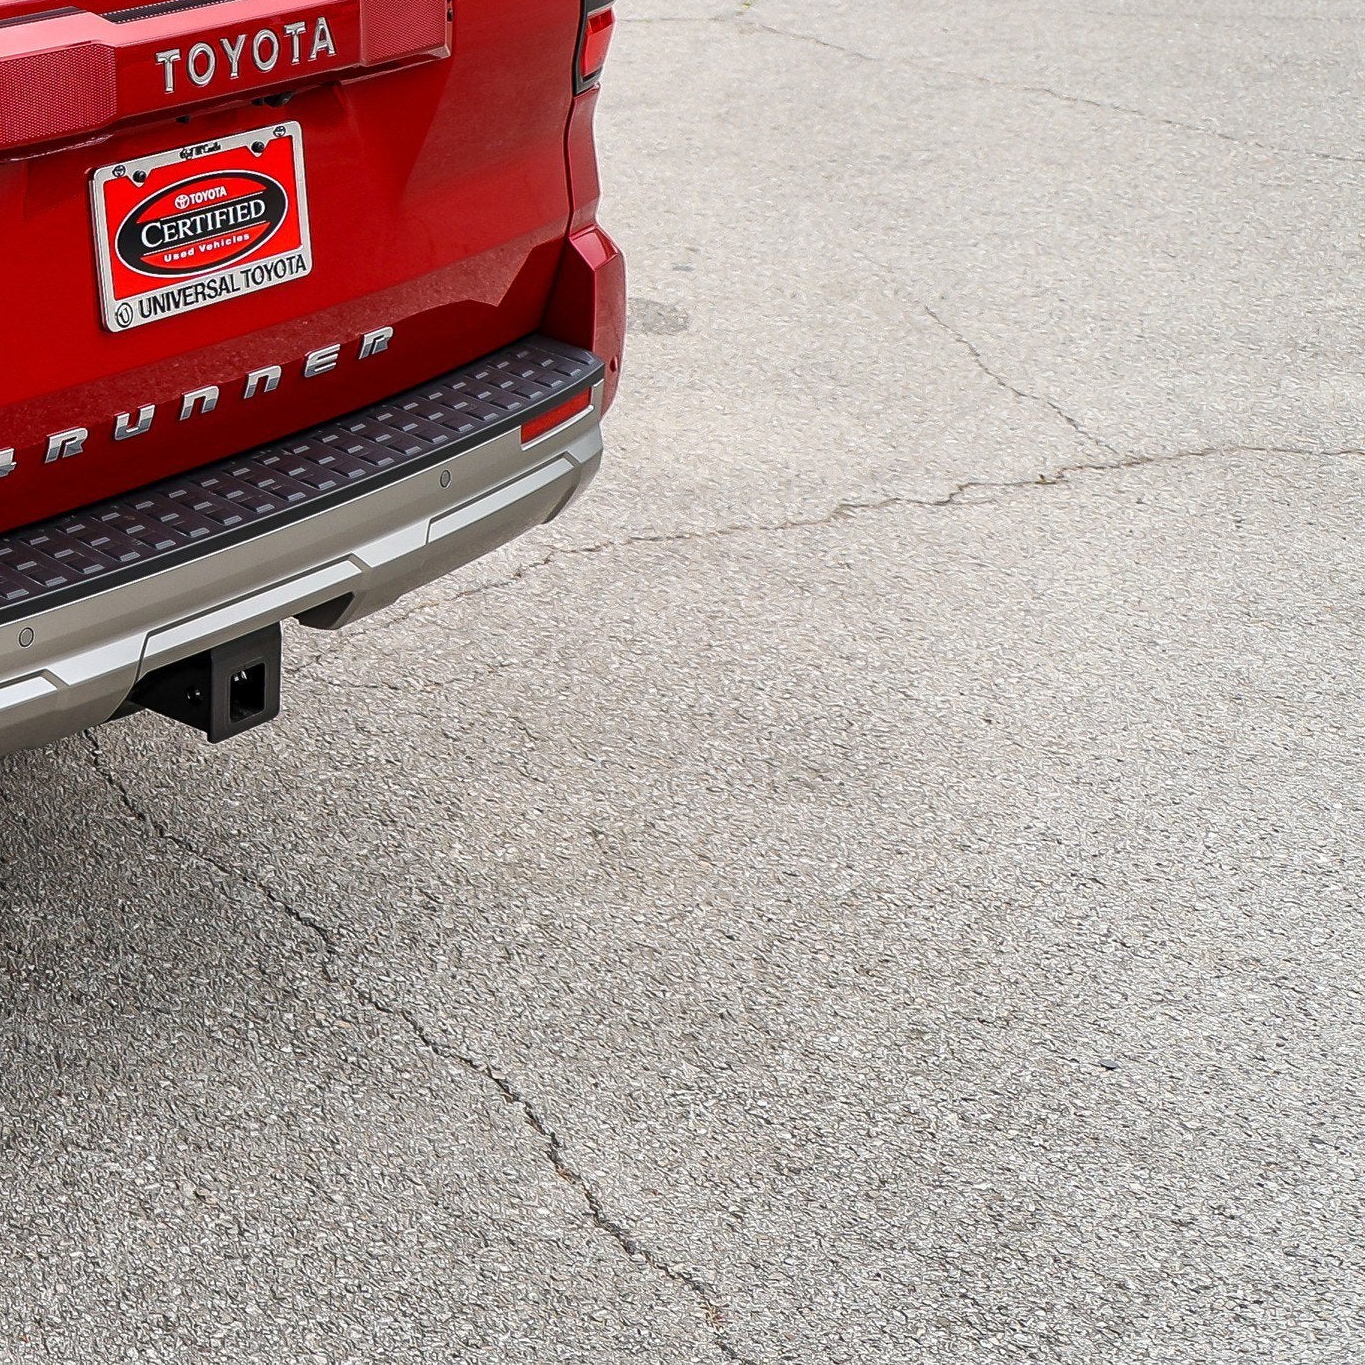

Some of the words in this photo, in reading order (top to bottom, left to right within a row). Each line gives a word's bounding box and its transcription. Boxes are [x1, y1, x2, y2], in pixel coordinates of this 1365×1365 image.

[155, 17, 336, 93] TOYOTA
[190, 186, 228, 205] TOYOTA
[141, 198, 267, 248] CERTIFIED
[163, 247, 195, 263] Used
[199, 232, 251, 253] Vehicles
[139, 274, 241, 319] UNIVERSAL
[240, 254, 307, 288] TOYOTA
